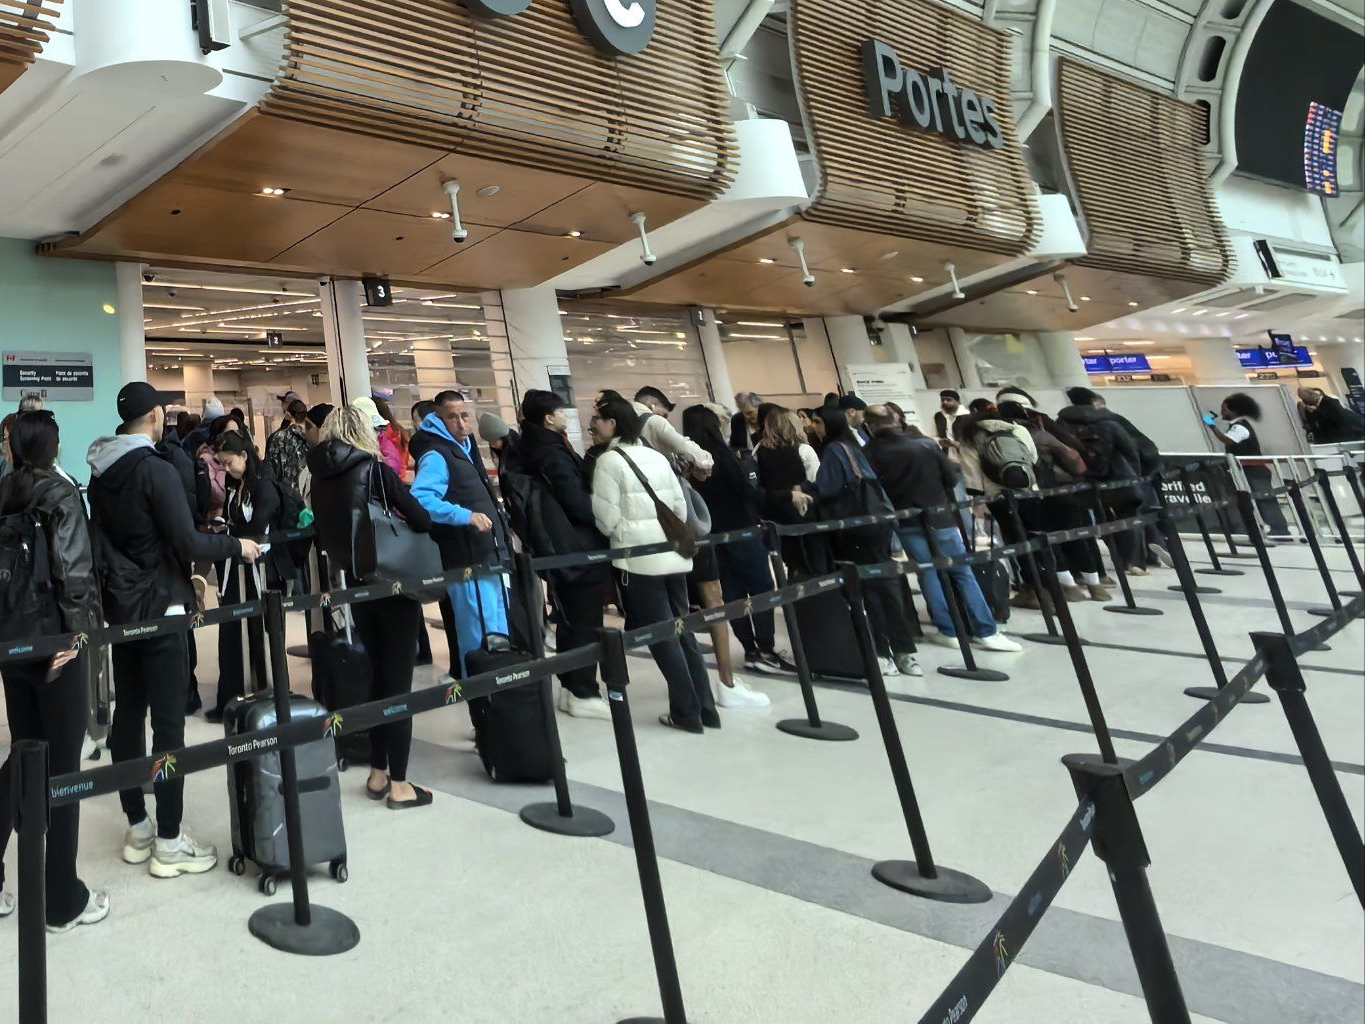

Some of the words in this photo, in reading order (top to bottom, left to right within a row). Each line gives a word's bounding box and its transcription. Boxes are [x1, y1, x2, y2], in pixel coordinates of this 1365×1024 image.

[871, 39, 1005, 149] Portes
[377, 285, 386, 298] 3
[228, 743, 254, 756] Toronto
[253, 736, 278, 750] Pearson
[51, 780, 94, 798] bienvenue
